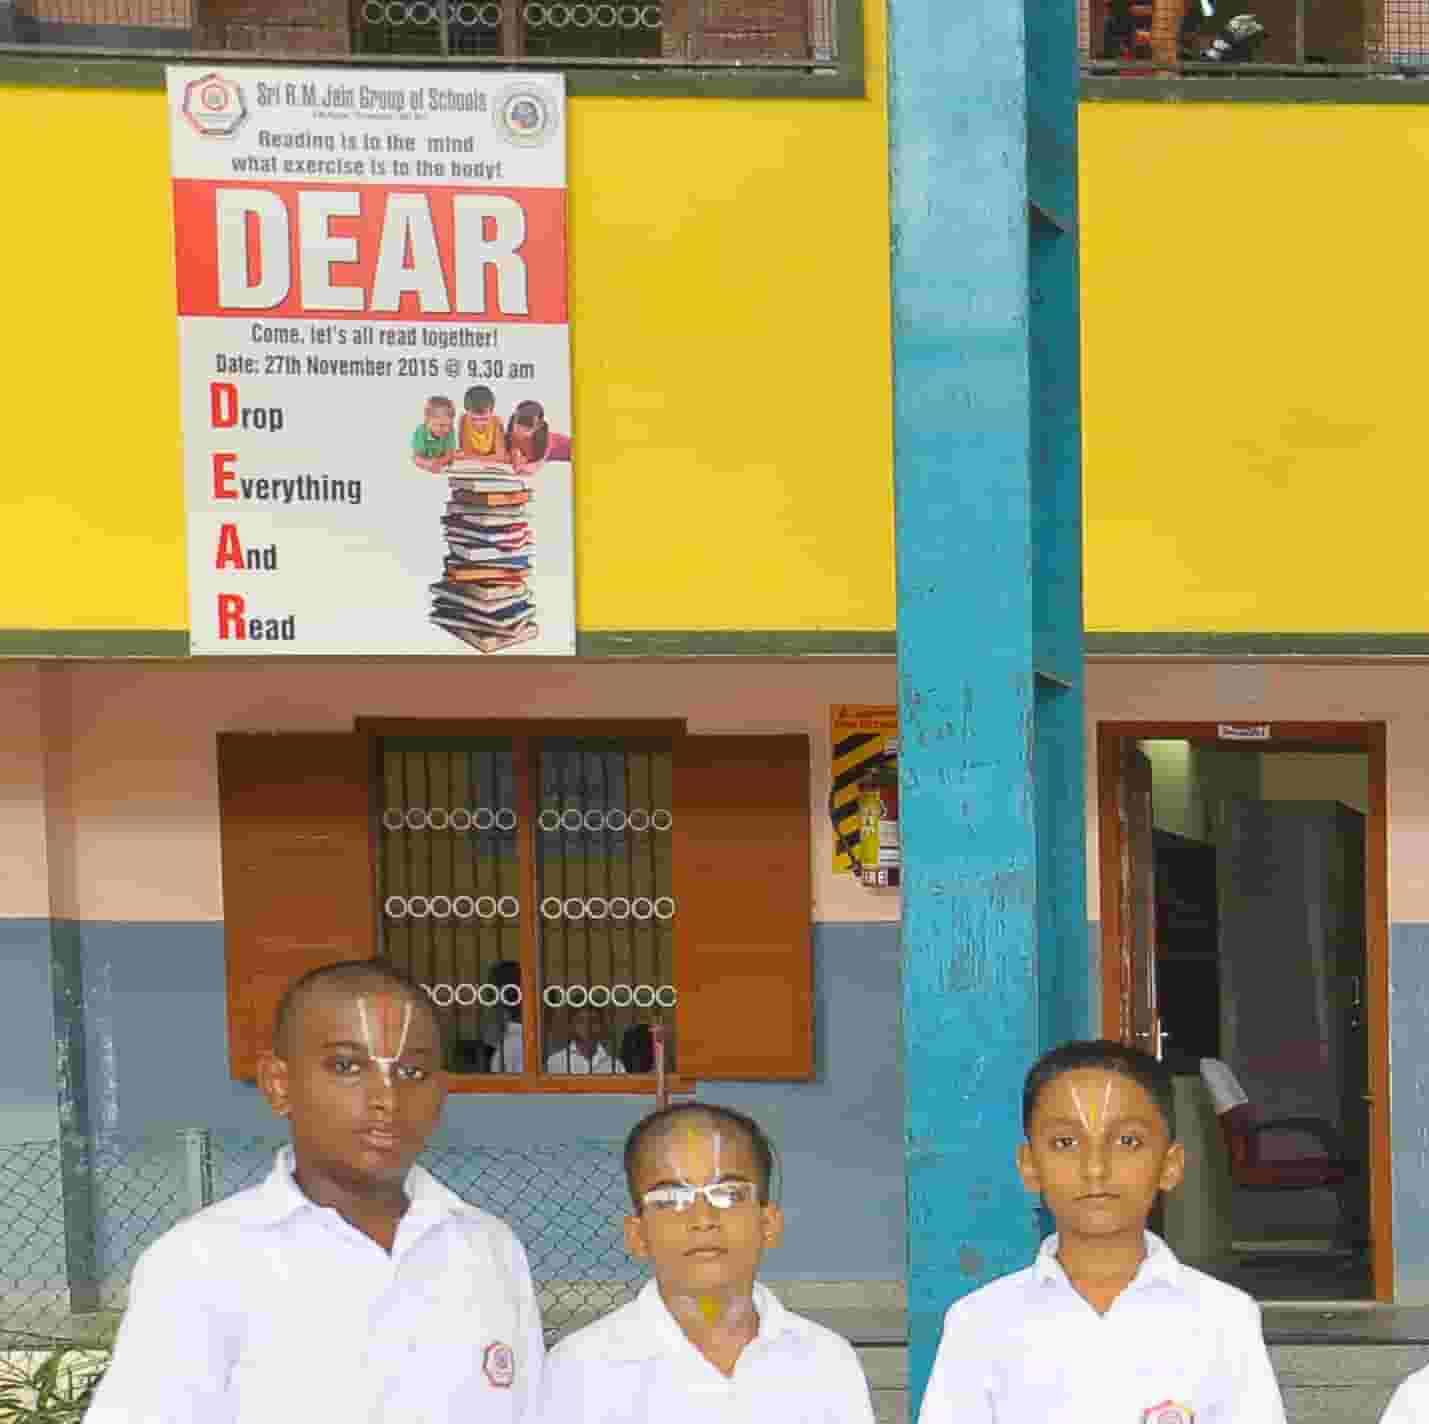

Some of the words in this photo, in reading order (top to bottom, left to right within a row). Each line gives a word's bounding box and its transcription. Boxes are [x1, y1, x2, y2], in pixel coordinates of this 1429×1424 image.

[256, 82, 280, 107] Sri
[360, 85, 405, 112] Group
[408, 87, 424, 110] of
[428, 87, 489, 112] Schools
[258, 130, 335, 152] Reading
[341, 132, 356, 150] is
[363, 133, 381, 151] to
[386, 133, 416, 152] the
[427, 135, 474, 153] mind
[231, 156, 278, 175] what
[283, 157, 364, 176] exercise
[371, 158, 386, 176] is
[392, 159, 409, 177] to
[415, 159, 445, 178] the
[451, 160, 502, 180] body!
[214, 187, 530, 315] DEAR
[310, 323, 349, 346] let's
[352, 325, 374, 346] all
[379, 326, 417, 347] read
[422, 328, 498, 350] together!
[216, 353, 261, 376] Date:
[265, 354, 301, 376] 27th
[306, 355, 394, 378] November
[399, 358, 440, 378] 2015
[445, 358, 462, 378] @
[508, 364, 536, 380] am
[210, 381, 284, 432] Drop
[211, 452, 362, 504] Everything
[214, 523, 277, 571] And
[216, 592, 296, 642] Read
